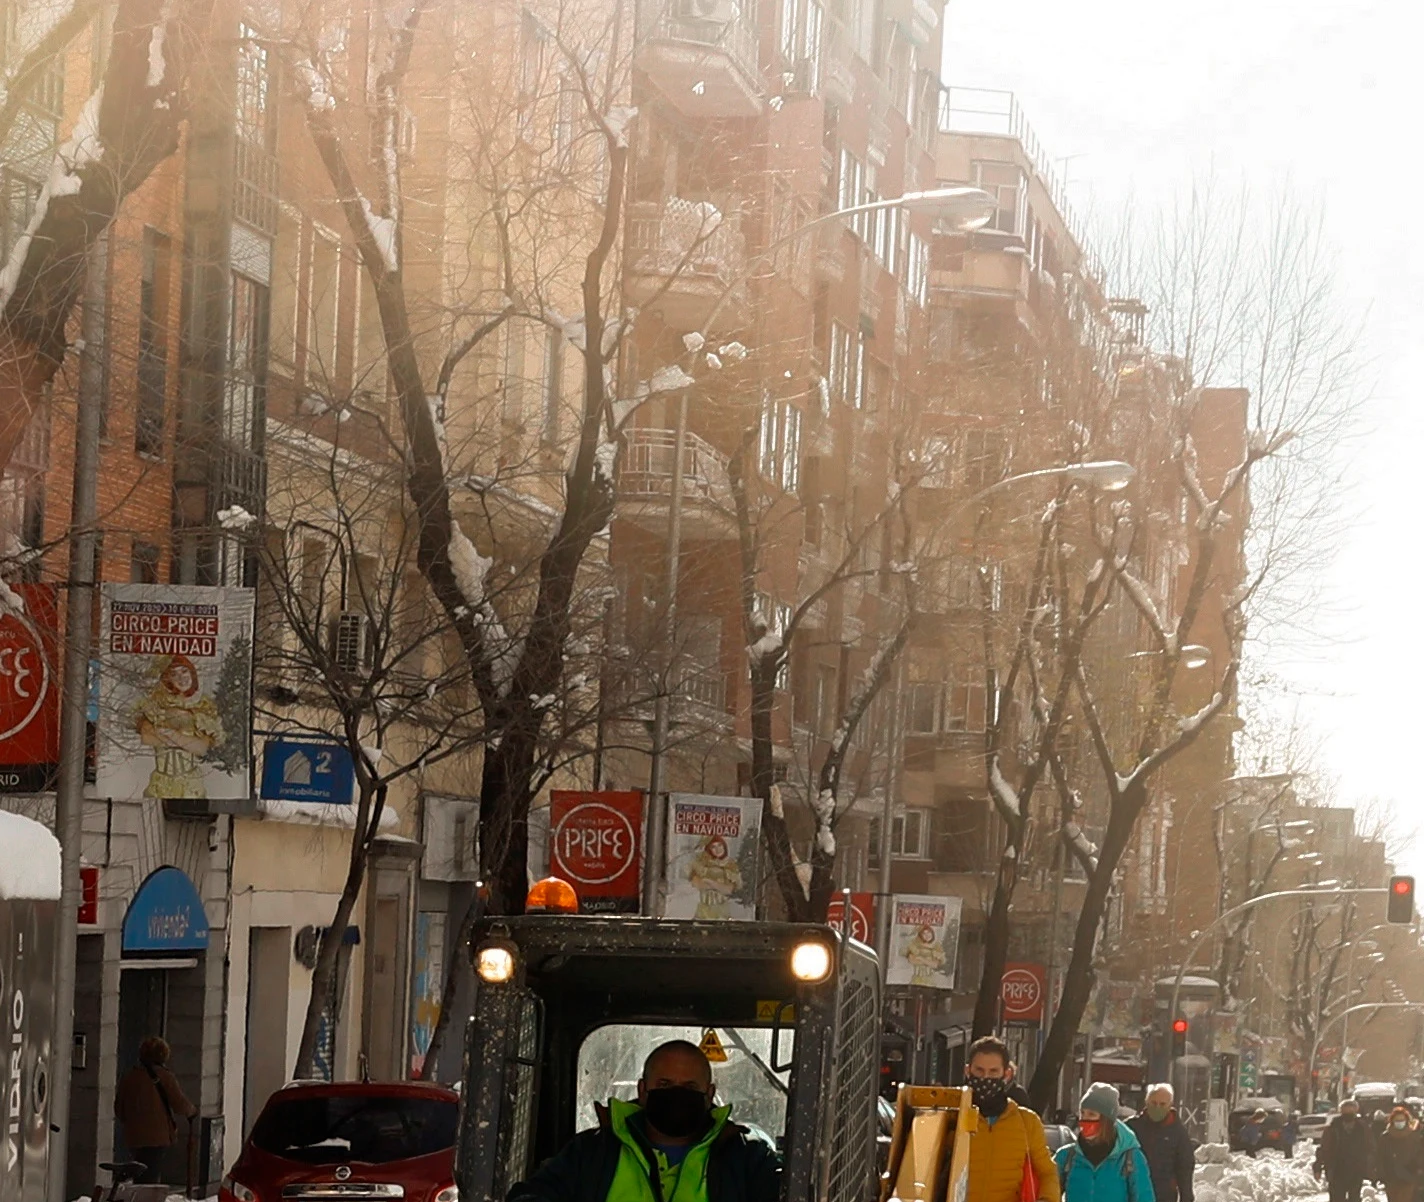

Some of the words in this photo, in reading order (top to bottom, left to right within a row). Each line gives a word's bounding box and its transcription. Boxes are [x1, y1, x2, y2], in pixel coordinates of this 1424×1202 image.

[113, 614, 161, 632] CIRCO
[168, 617, 216, 634] PRICE
[112, 635, 133, 652] EN
[140, 636, 212, 655] NAVIDAD
[676, 811, 706, 822] CIRCO
[709, 813, 739, 825] PRICE
[675, 823, 689, 833] EN
[693, 824, 737, 836] NAVIDAD
[565, 828, 624, 860] PRICE
[1002, 982, 1035, 1000] PRICE
[7, 989, 24, 1172] VIDRIO
